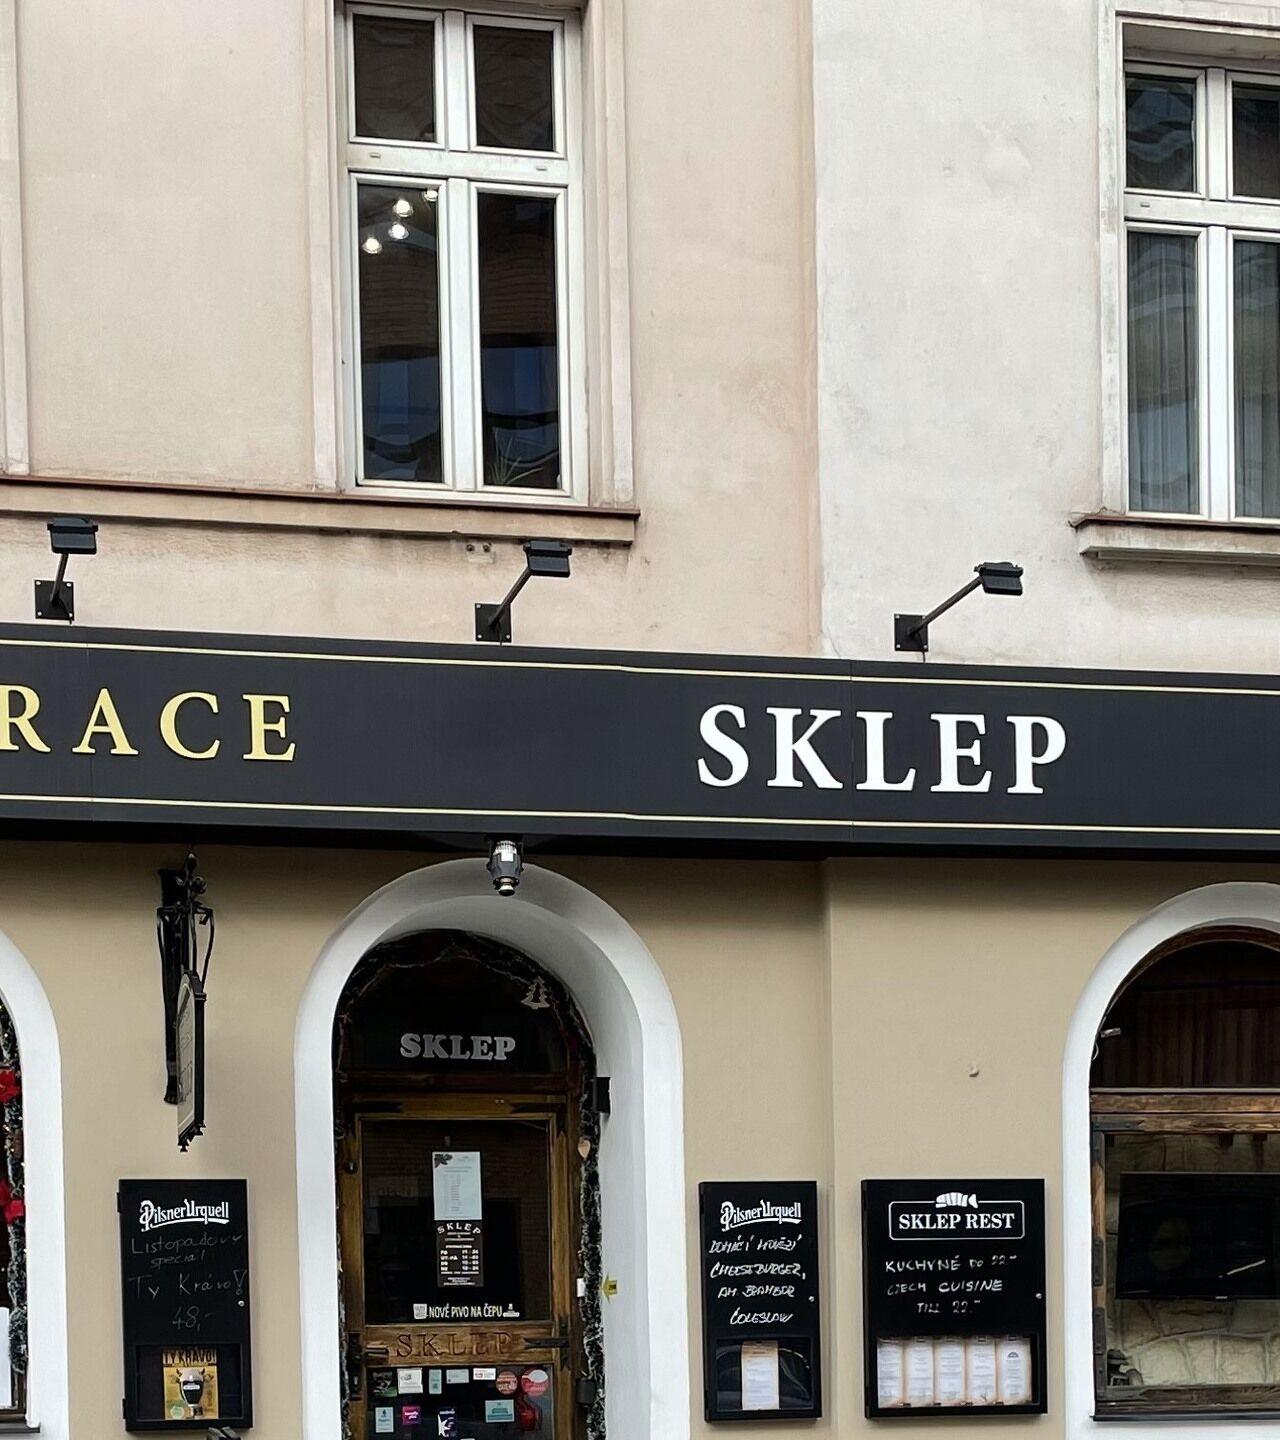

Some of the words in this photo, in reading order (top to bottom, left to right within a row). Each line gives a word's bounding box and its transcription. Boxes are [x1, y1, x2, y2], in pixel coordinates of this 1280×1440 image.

[697, 703, 1067, 795] SKLEP
[400, 1032, 516, 1061] SKLEP
[139, 1199, 187, 1233] Pilsner
[183, 1199, 230, 1225] Urquell
[720, 1201, 763, 1232] Pilsner
[760, 1200, 802, 1225] Urquell
[898, 1213, 961, 1230] SKLEP
[965, 1212, 1016, 1229] REST
[437, 1222, 481, 1234] SKLEP
[969, 1258, 984, 1268] DO
[938, 1279, 1003, 1293] CUISINE
[429, 1303, 449, 1318] NOVÉ
[451, 1305, 469, 1318] PIVO
[470, 1305, 482, 1318] NA
[483, 1303, 502, 1318] ČEPU
[396, 1331, 511, 1358] SKLEP
